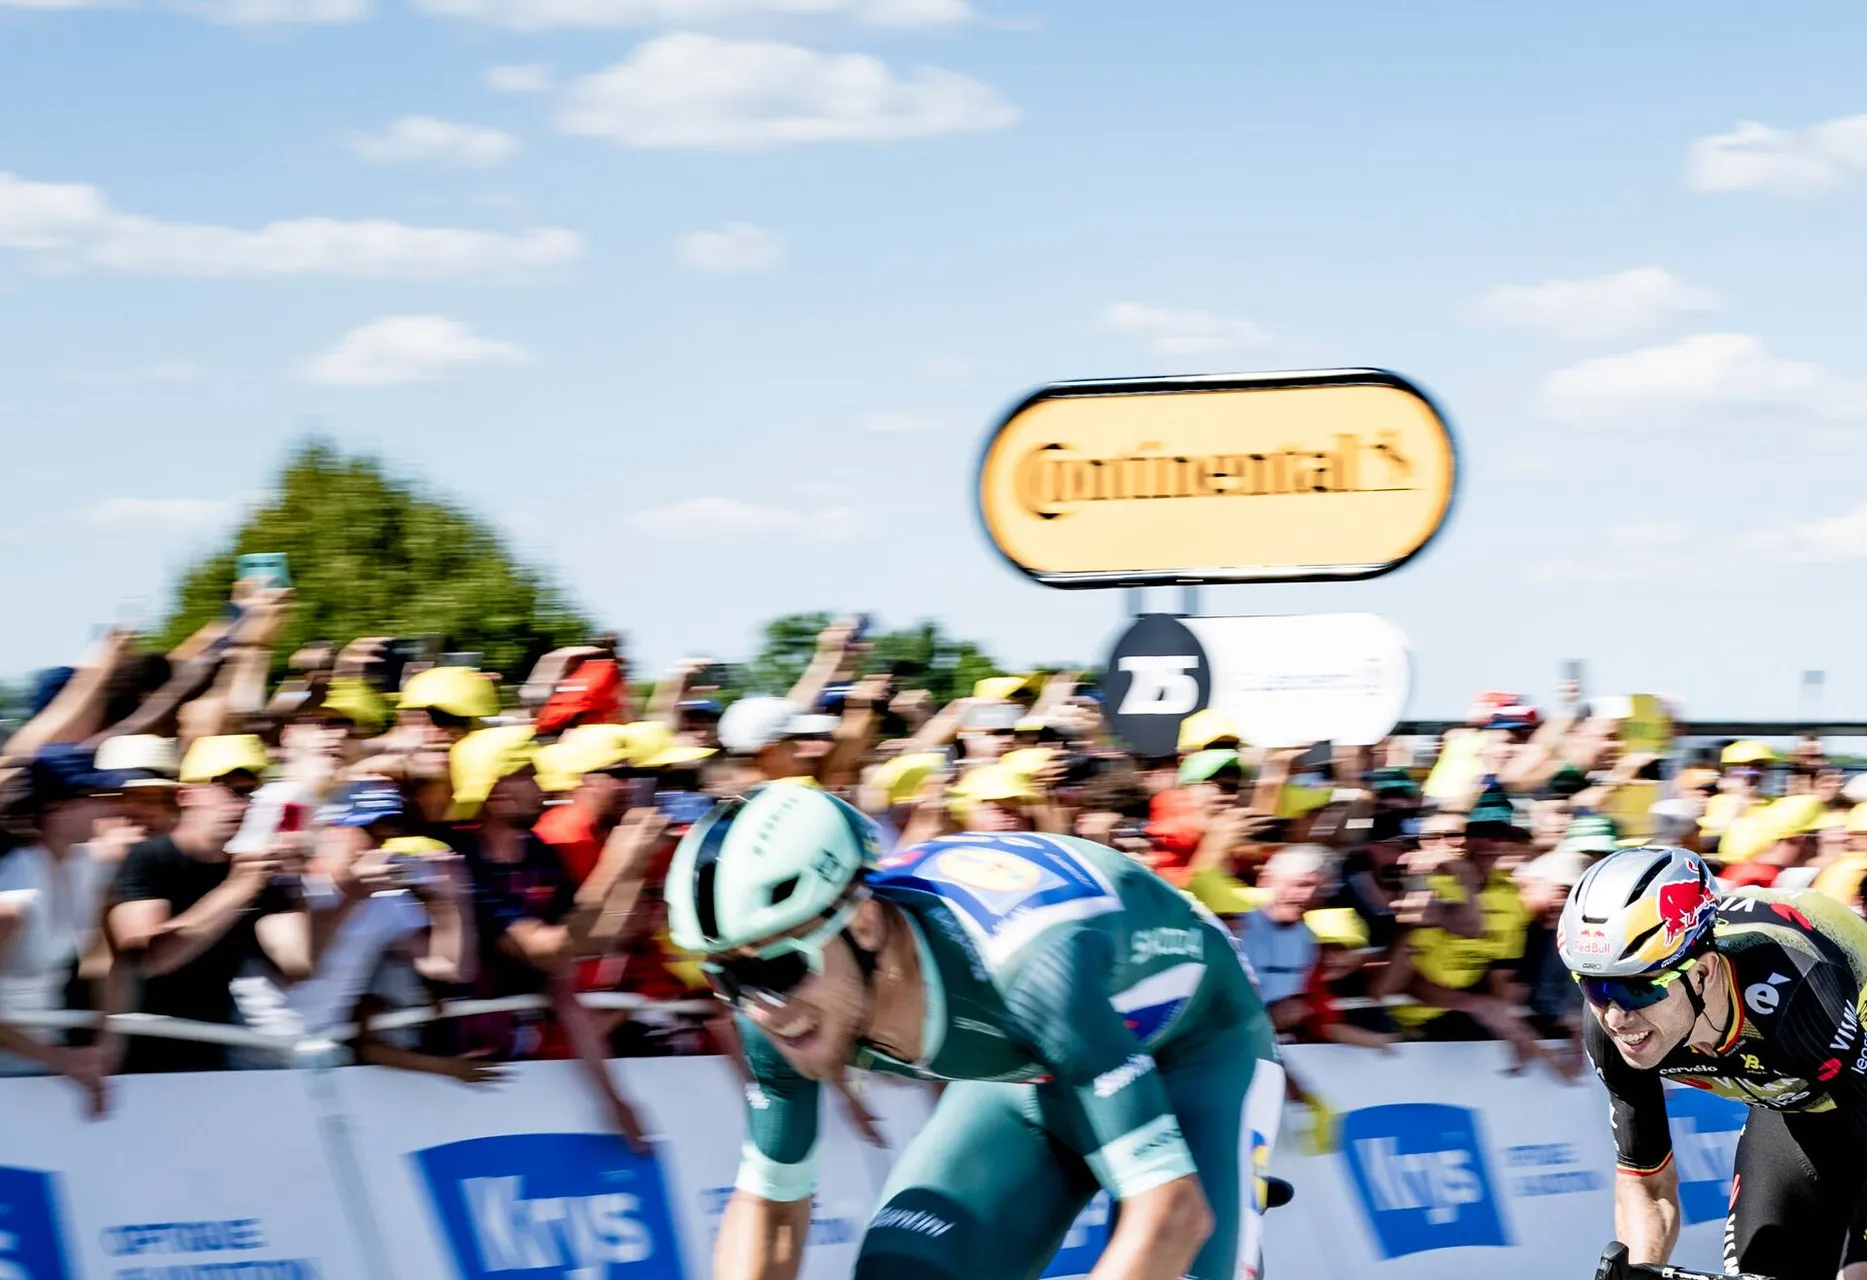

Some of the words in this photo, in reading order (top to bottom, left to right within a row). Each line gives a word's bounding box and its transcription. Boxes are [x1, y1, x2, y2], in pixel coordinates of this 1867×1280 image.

[1012, 432, 1358, 520] Continental
[1117, 655, 1200, 715] 25
[1592, 942, 1611, 954] Bull
[1661, 948, 1686, 969] GIRO
[1659, 1064, 1718, 1075] cervélo
